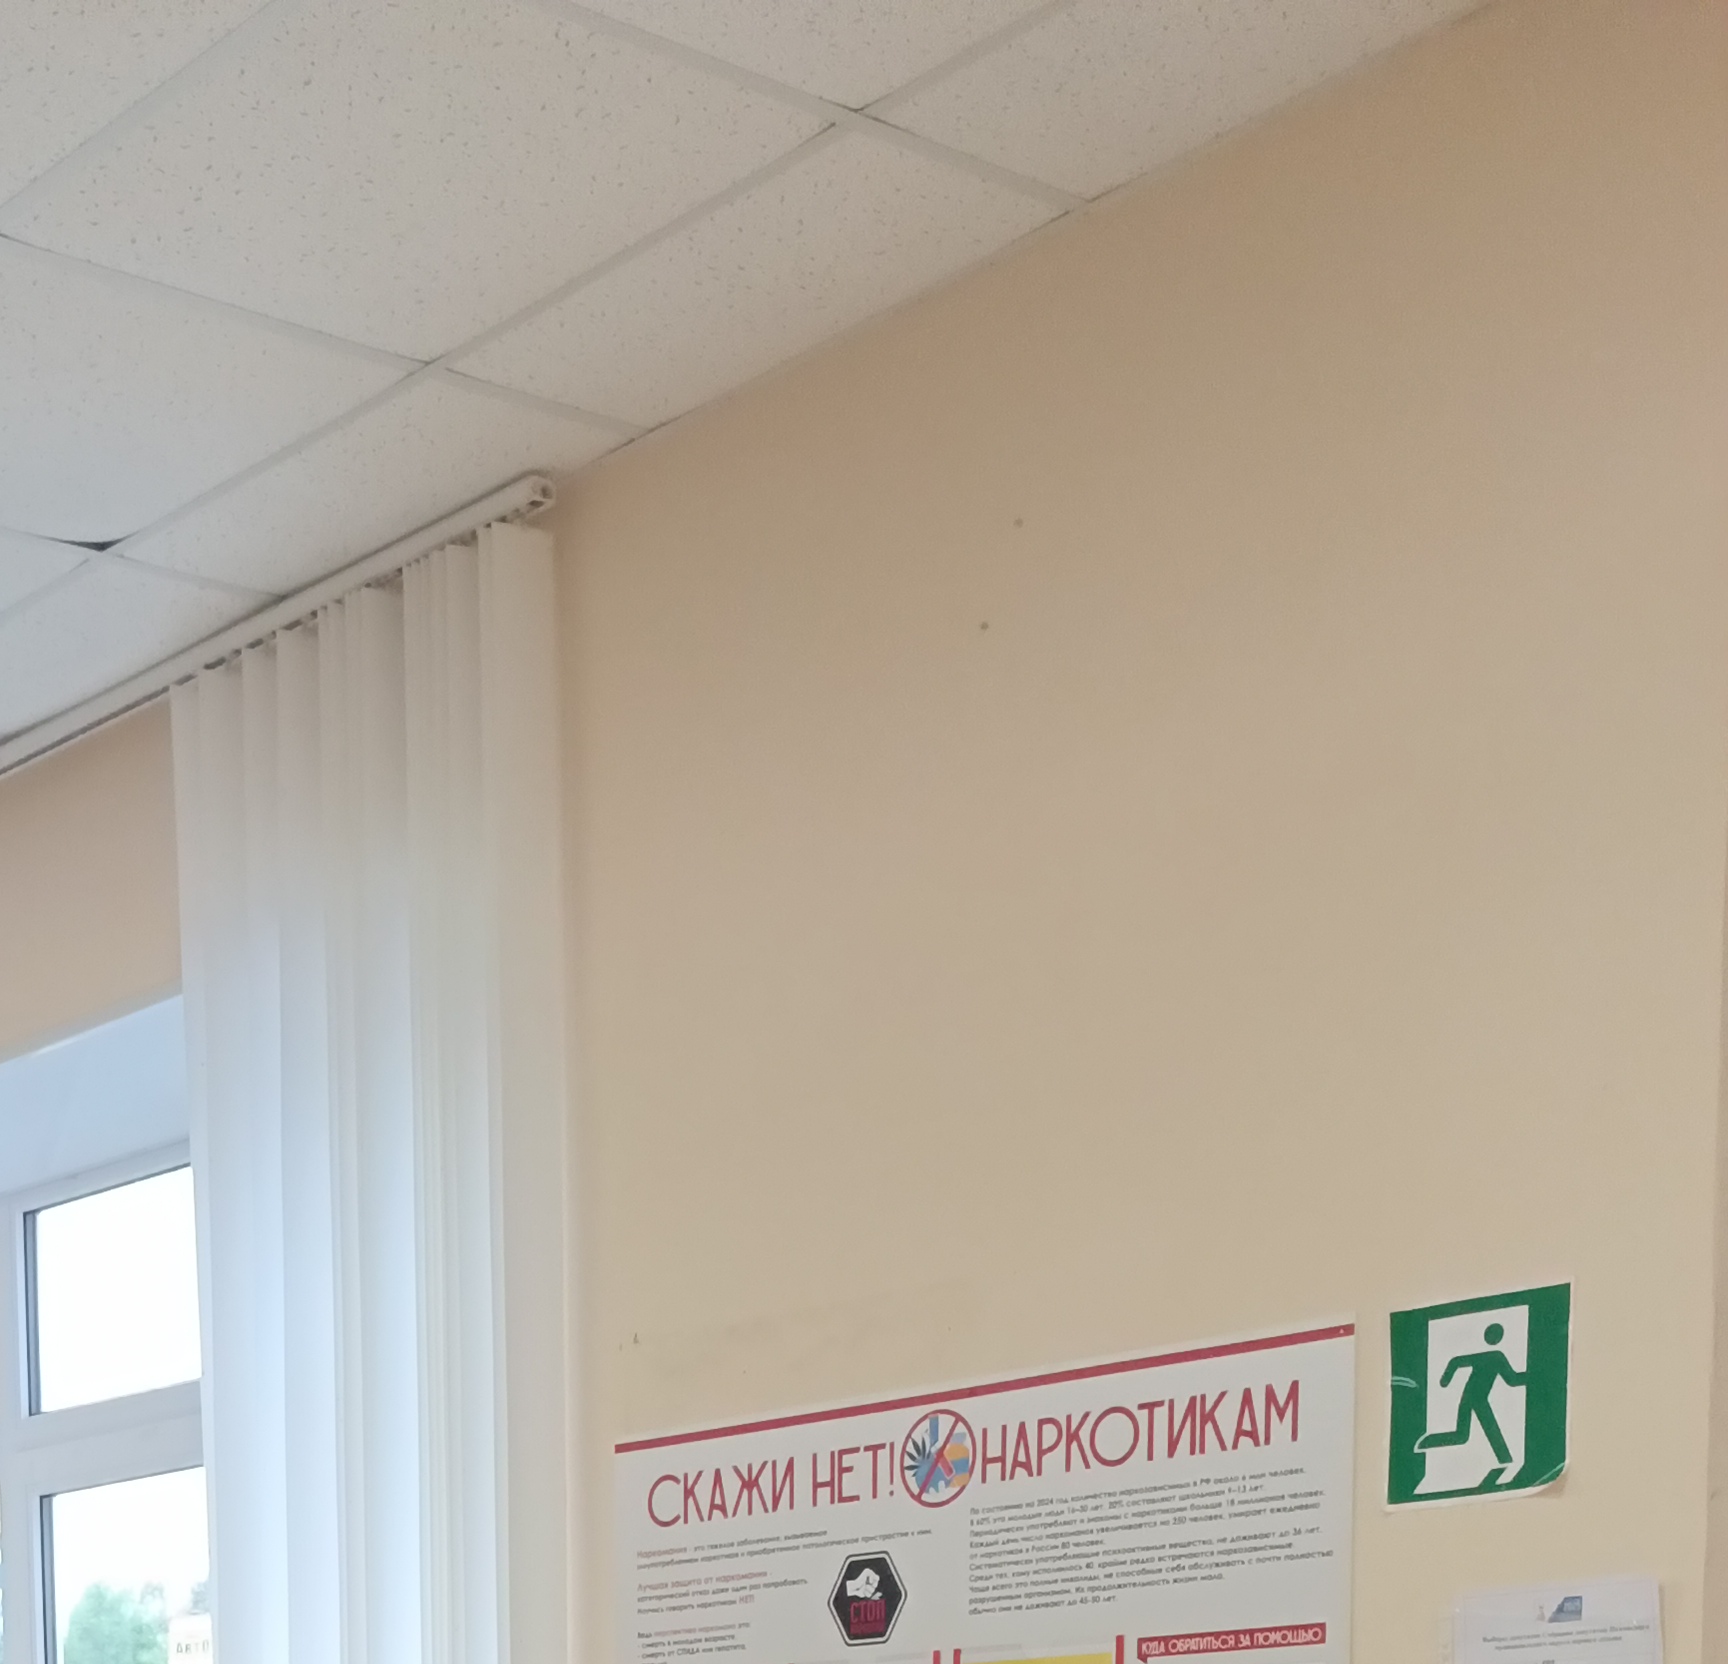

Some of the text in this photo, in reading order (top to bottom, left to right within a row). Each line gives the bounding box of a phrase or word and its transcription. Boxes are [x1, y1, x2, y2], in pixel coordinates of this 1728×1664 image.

[647, 1380, 1299, 1527] СКАЖИ НЕТ! НАРКОТИКАМ
[850, 1600, 885, 1623] СТОП
[1142, 1627, 1322, 1655] КУДА ОБРАТИТЬСЯ ЗА ПОМОЩЬЮ
